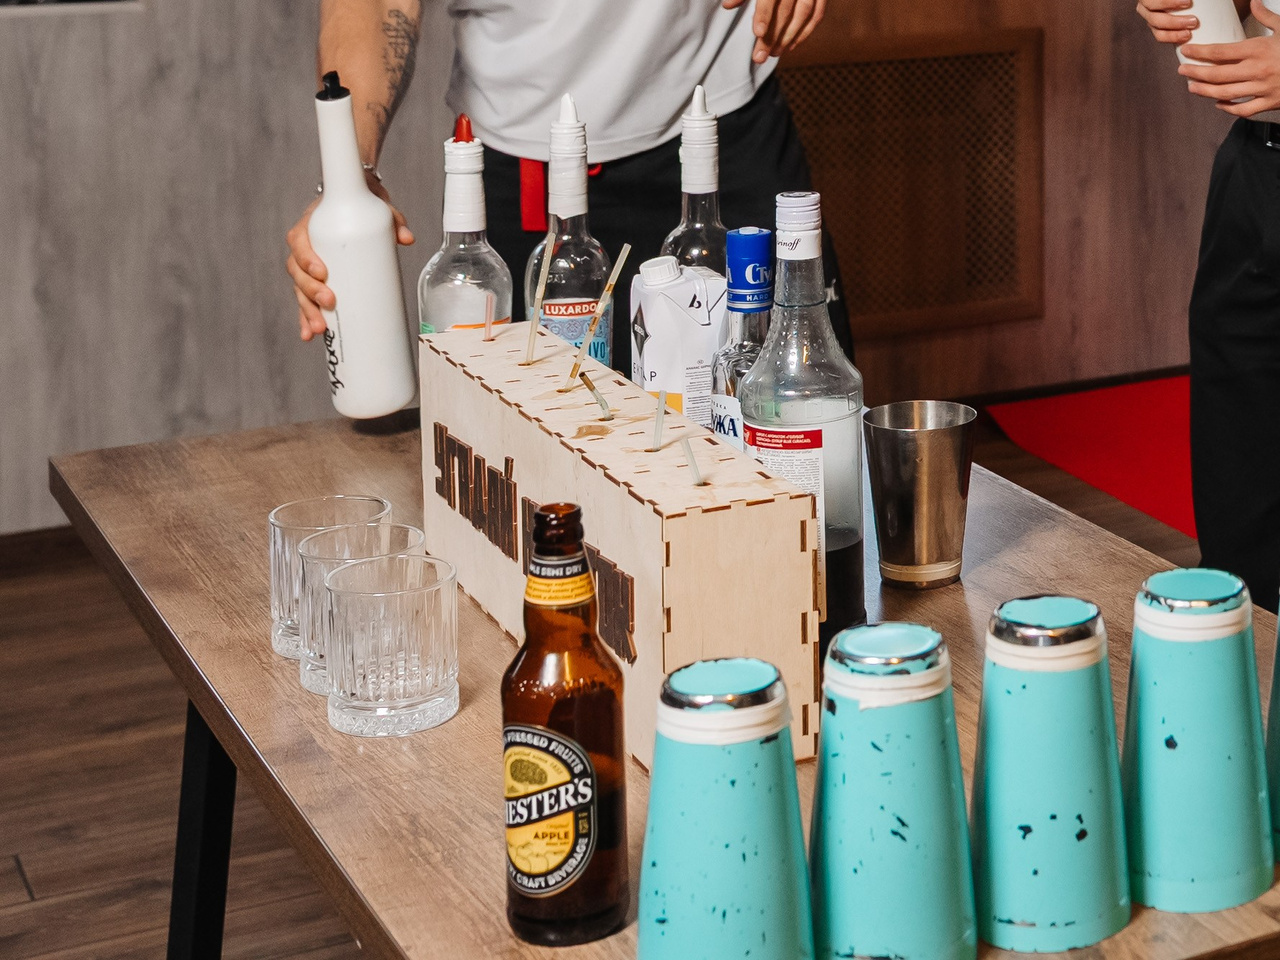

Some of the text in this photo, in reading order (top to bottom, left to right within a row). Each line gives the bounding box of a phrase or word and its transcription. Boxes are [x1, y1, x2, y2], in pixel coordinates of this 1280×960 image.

[544, 302, 599, 315] LUXARDO
[505, 778, 593, 825] ESTER'S
[533, 831, 570, 840] APPLE
